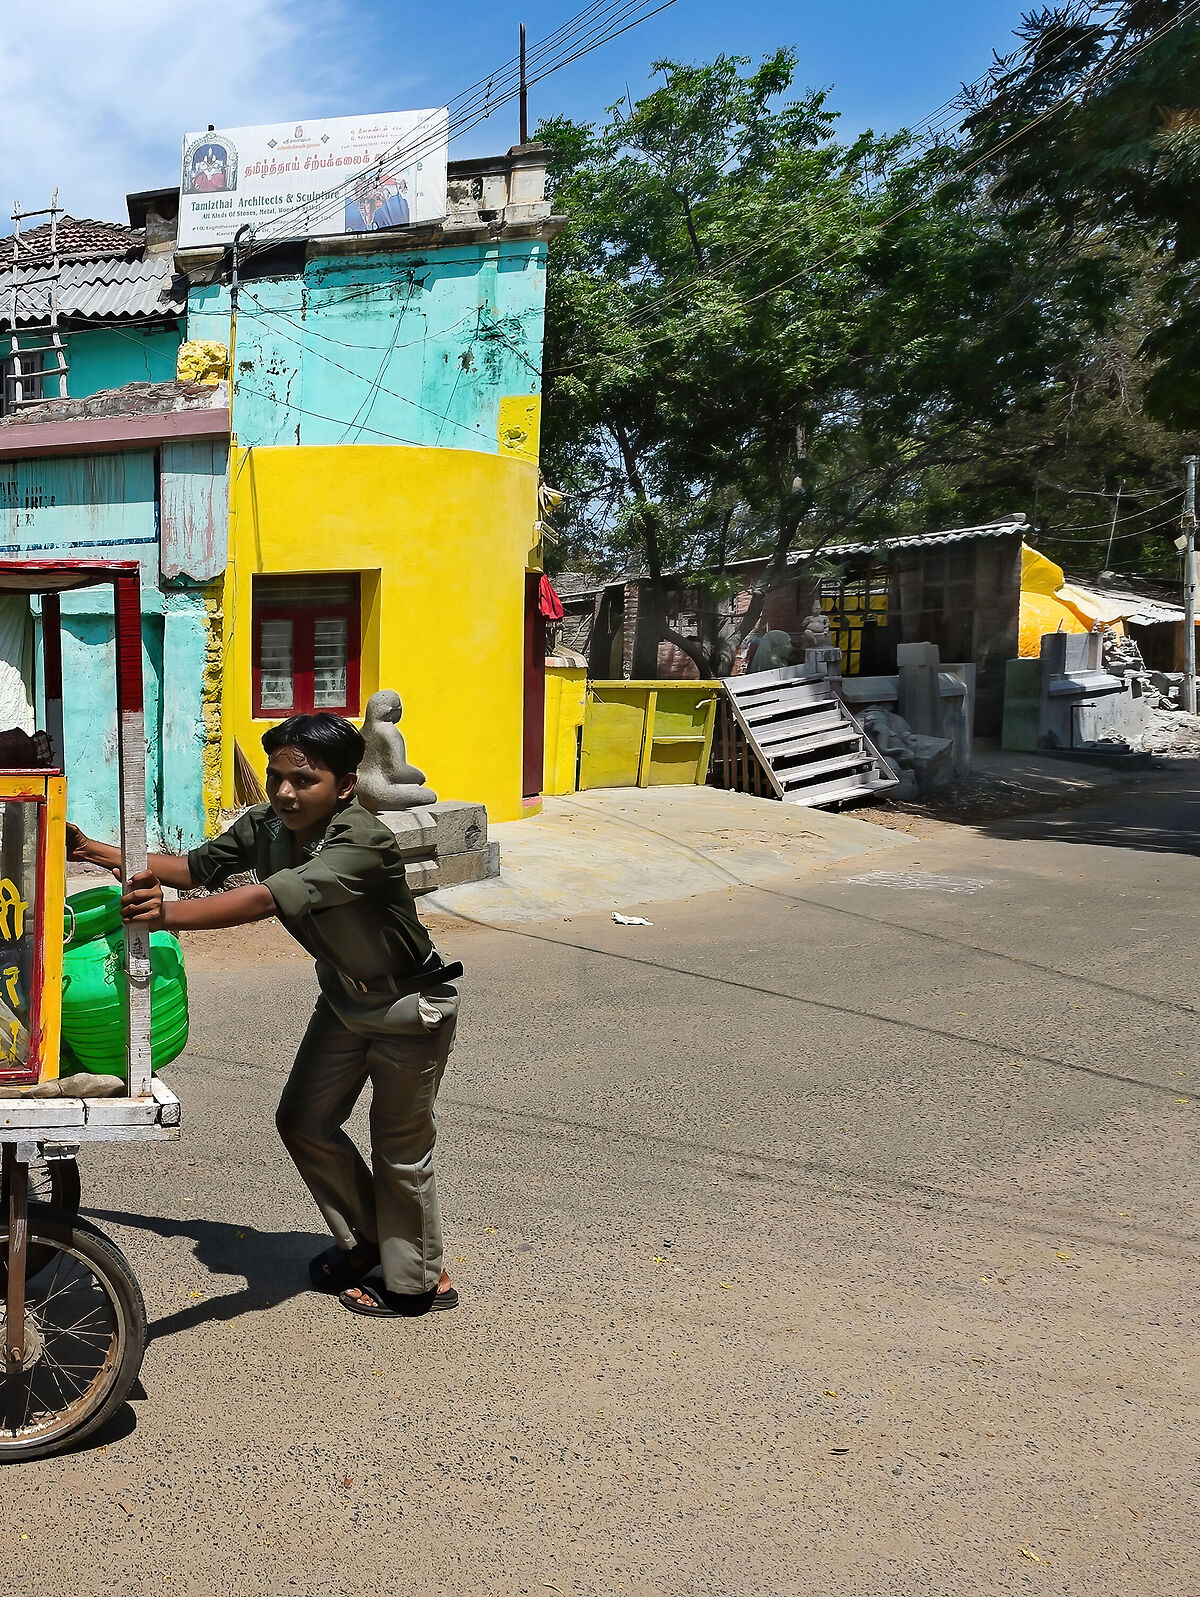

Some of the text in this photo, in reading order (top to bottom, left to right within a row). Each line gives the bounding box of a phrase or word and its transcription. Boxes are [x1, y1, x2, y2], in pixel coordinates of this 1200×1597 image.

[238, 194, 283, 207] Architects
[286, 193, 294, 203] &
[296, 190, 340, 204] Sculpture
